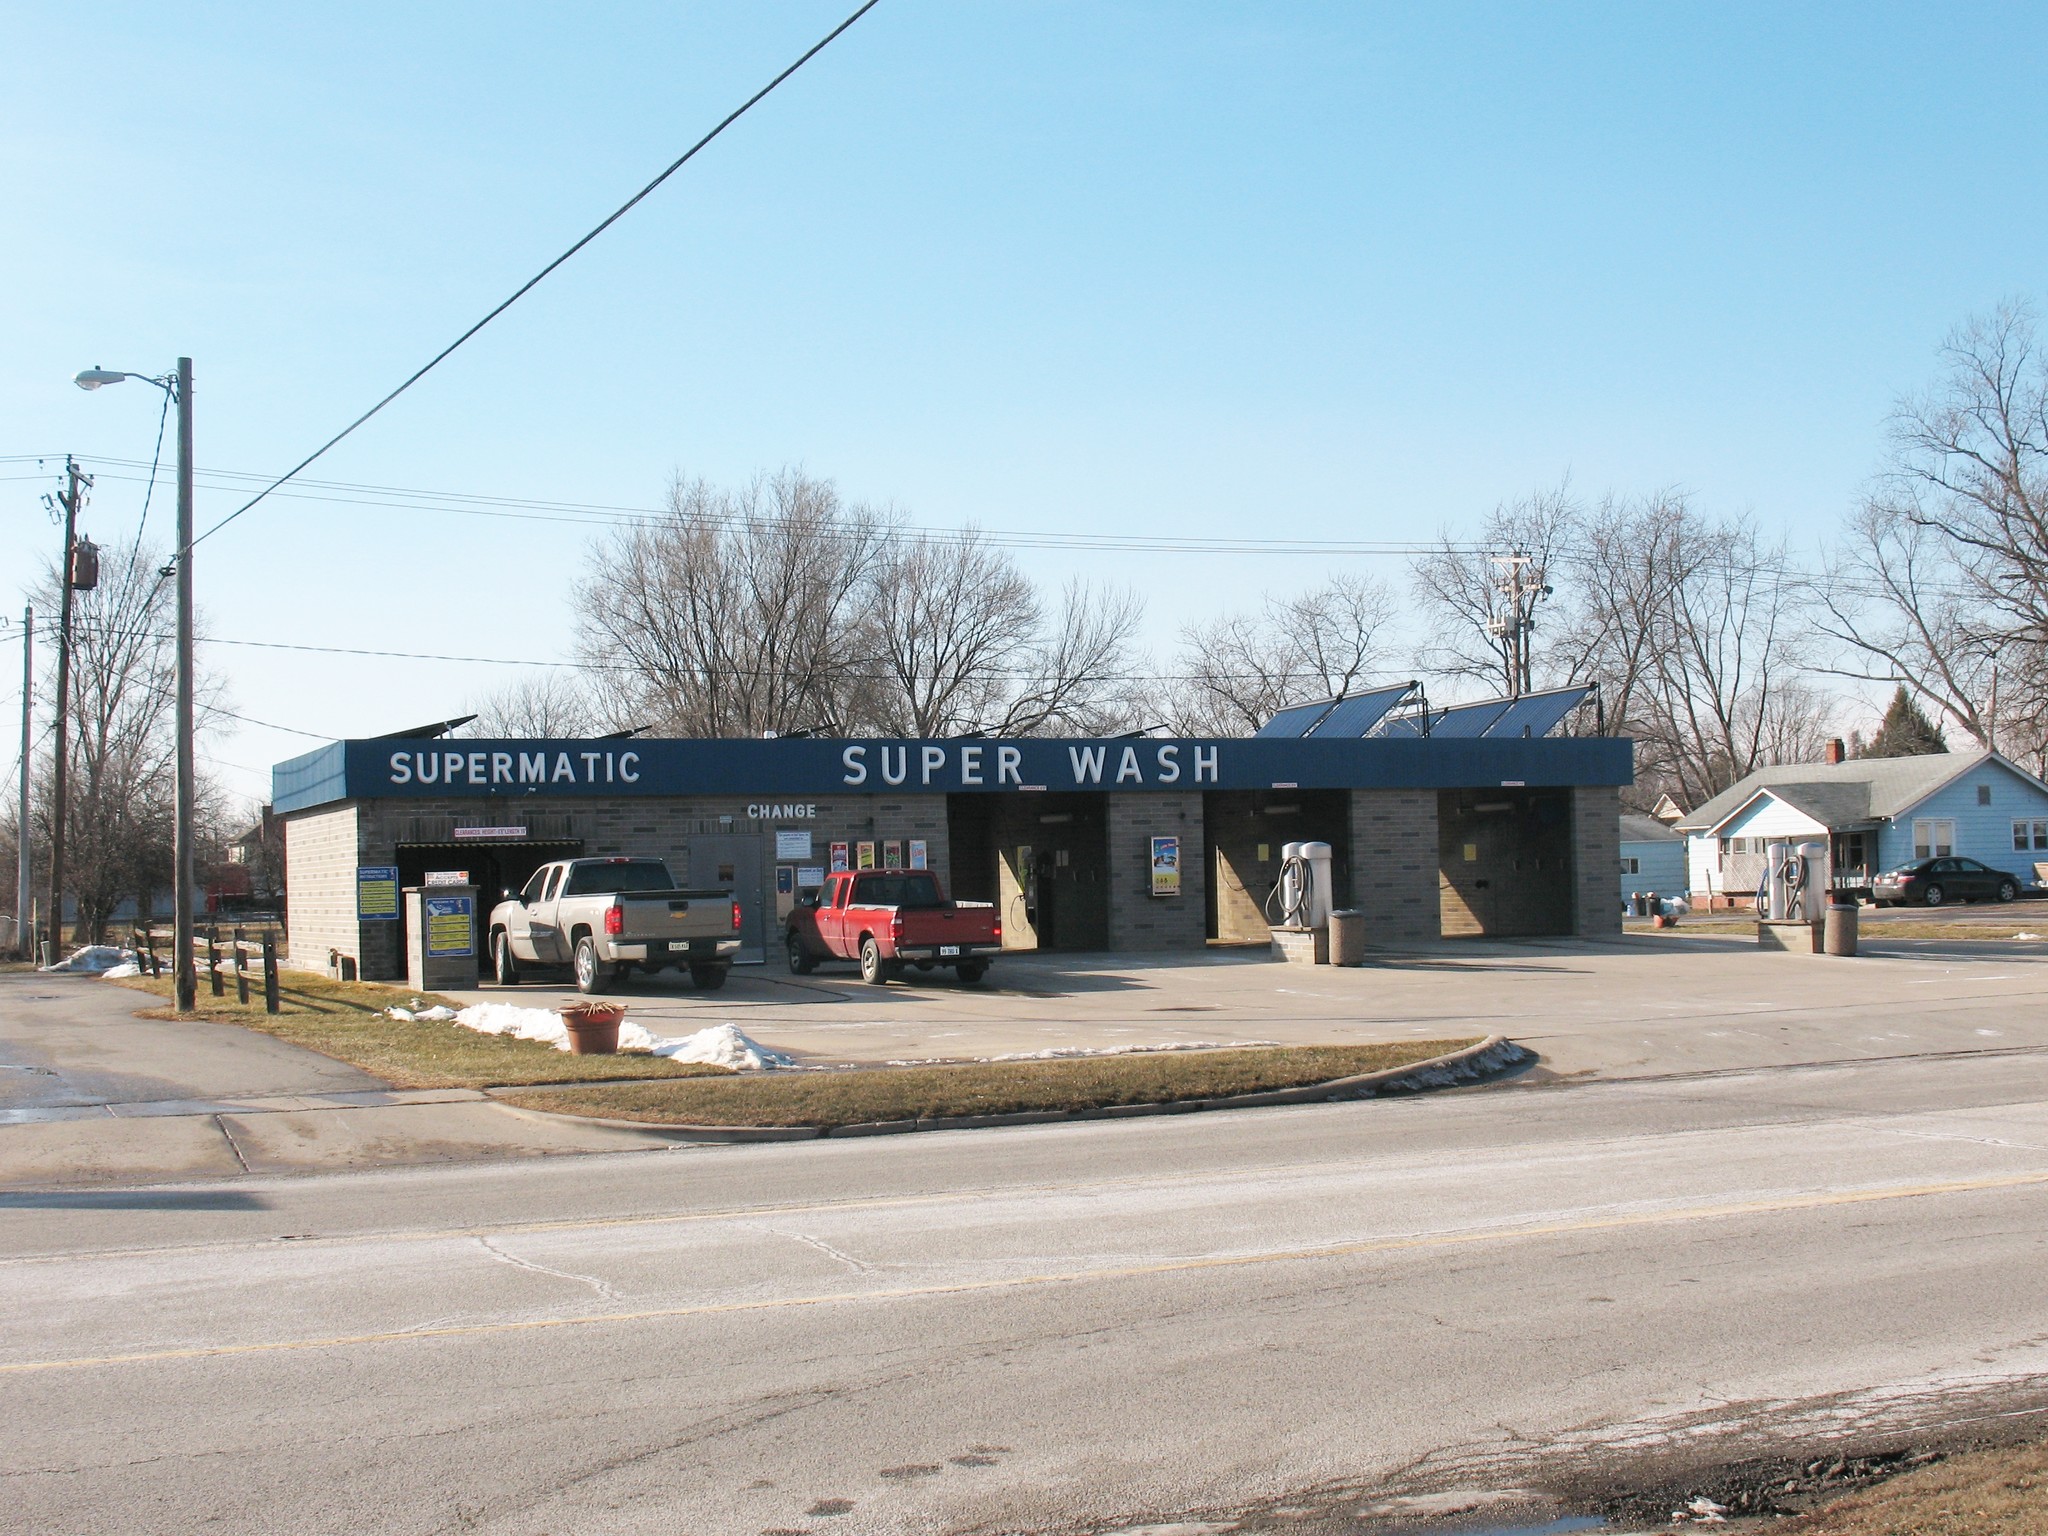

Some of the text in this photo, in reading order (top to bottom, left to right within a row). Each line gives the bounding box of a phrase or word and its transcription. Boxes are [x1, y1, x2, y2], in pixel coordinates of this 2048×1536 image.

[390, 752, 640, 784] SUPERMATIC
[842, 744, 1218, 785] SUPER WASH
[747, 803, 816, 819] CHANGE
